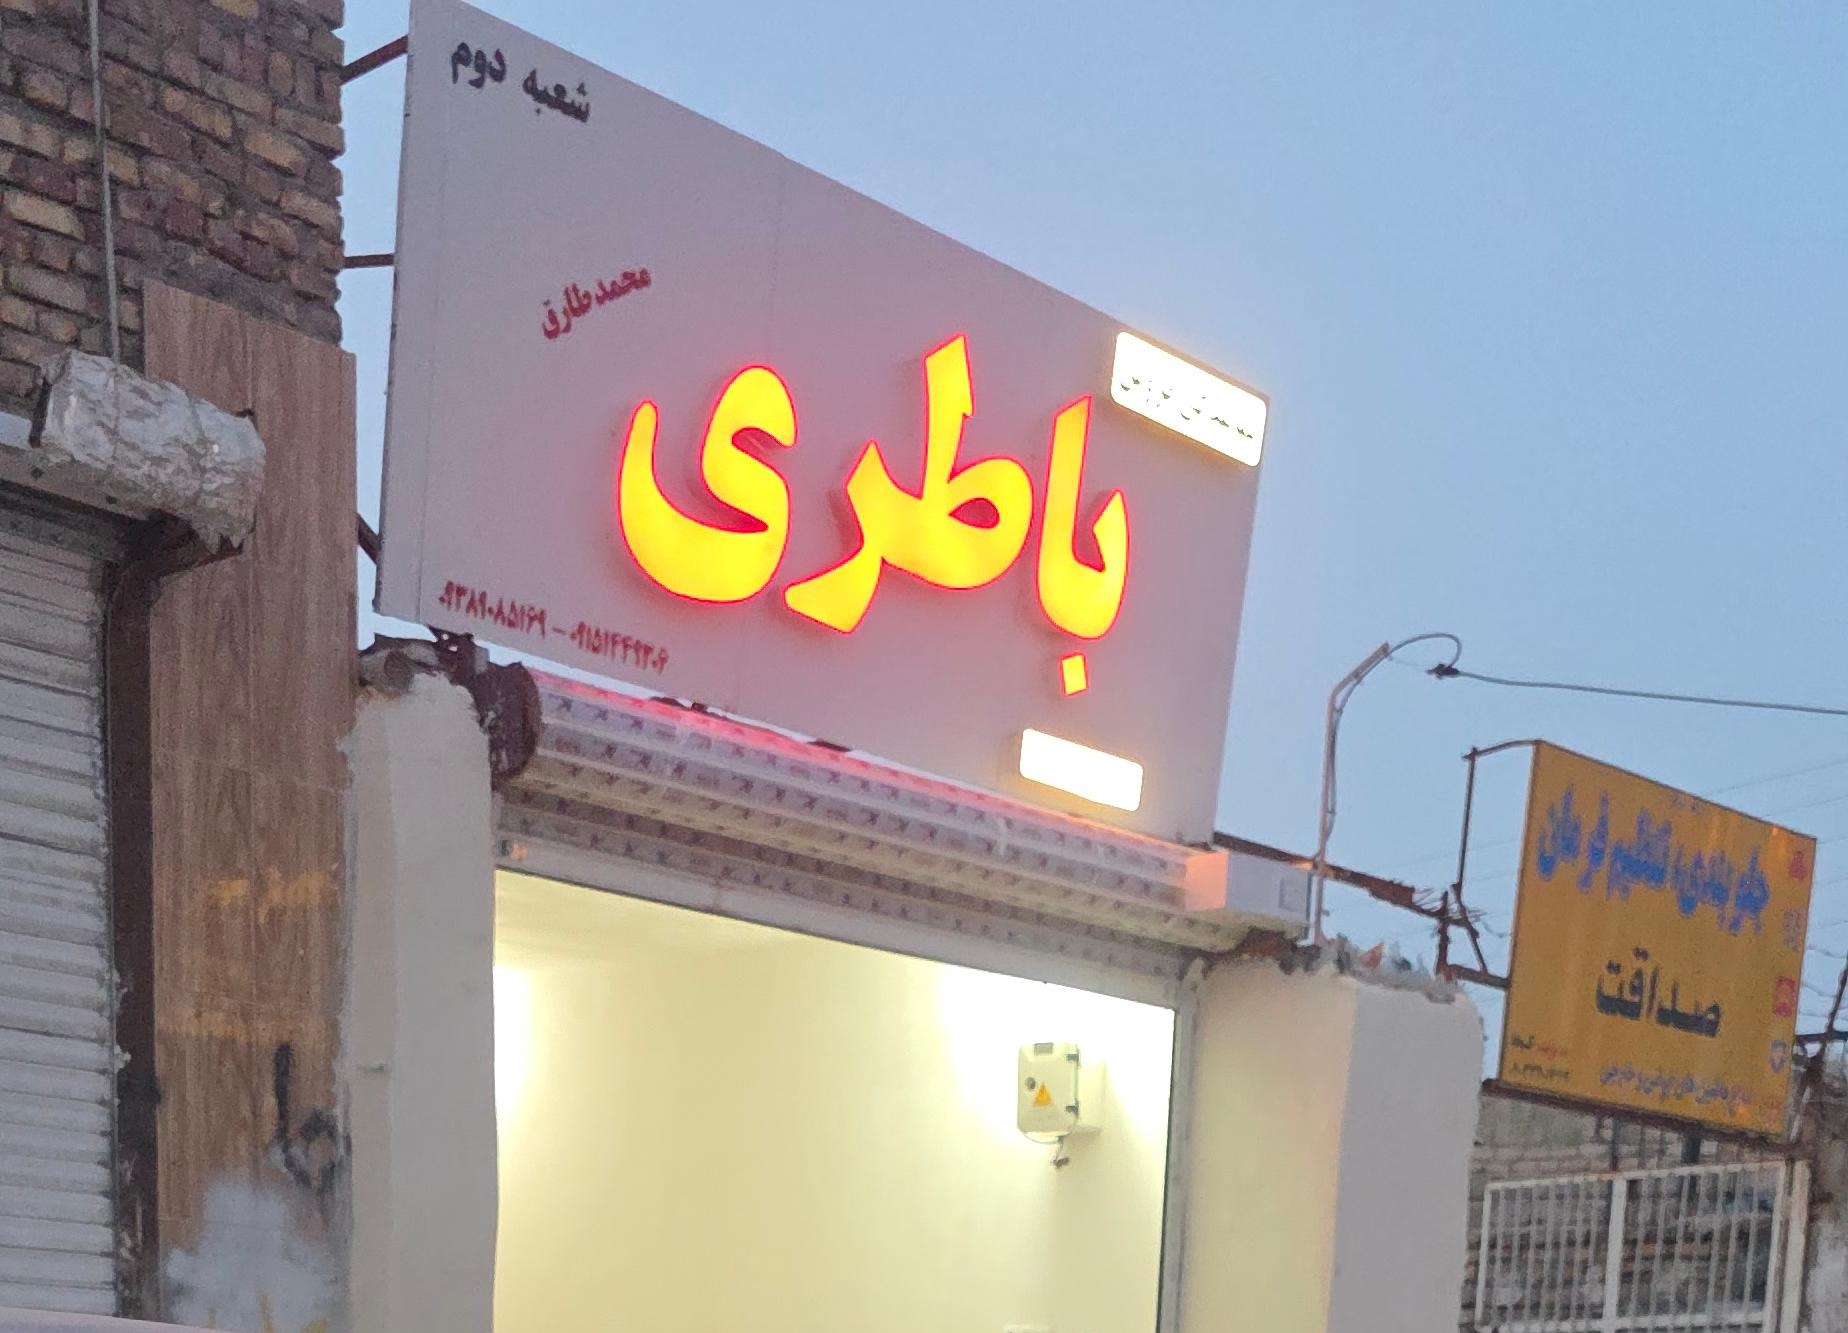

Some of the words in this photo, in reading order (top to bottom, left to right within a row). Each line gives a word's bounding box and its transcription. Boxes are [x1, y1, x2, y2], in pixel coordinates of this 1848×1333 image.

[451, 42, 506, 89] دوم
[522, 69, 591, 123] شعبه
[617, 333, 1130, 697] باطری
[1595, 946, 1722, 1038] صداقت
